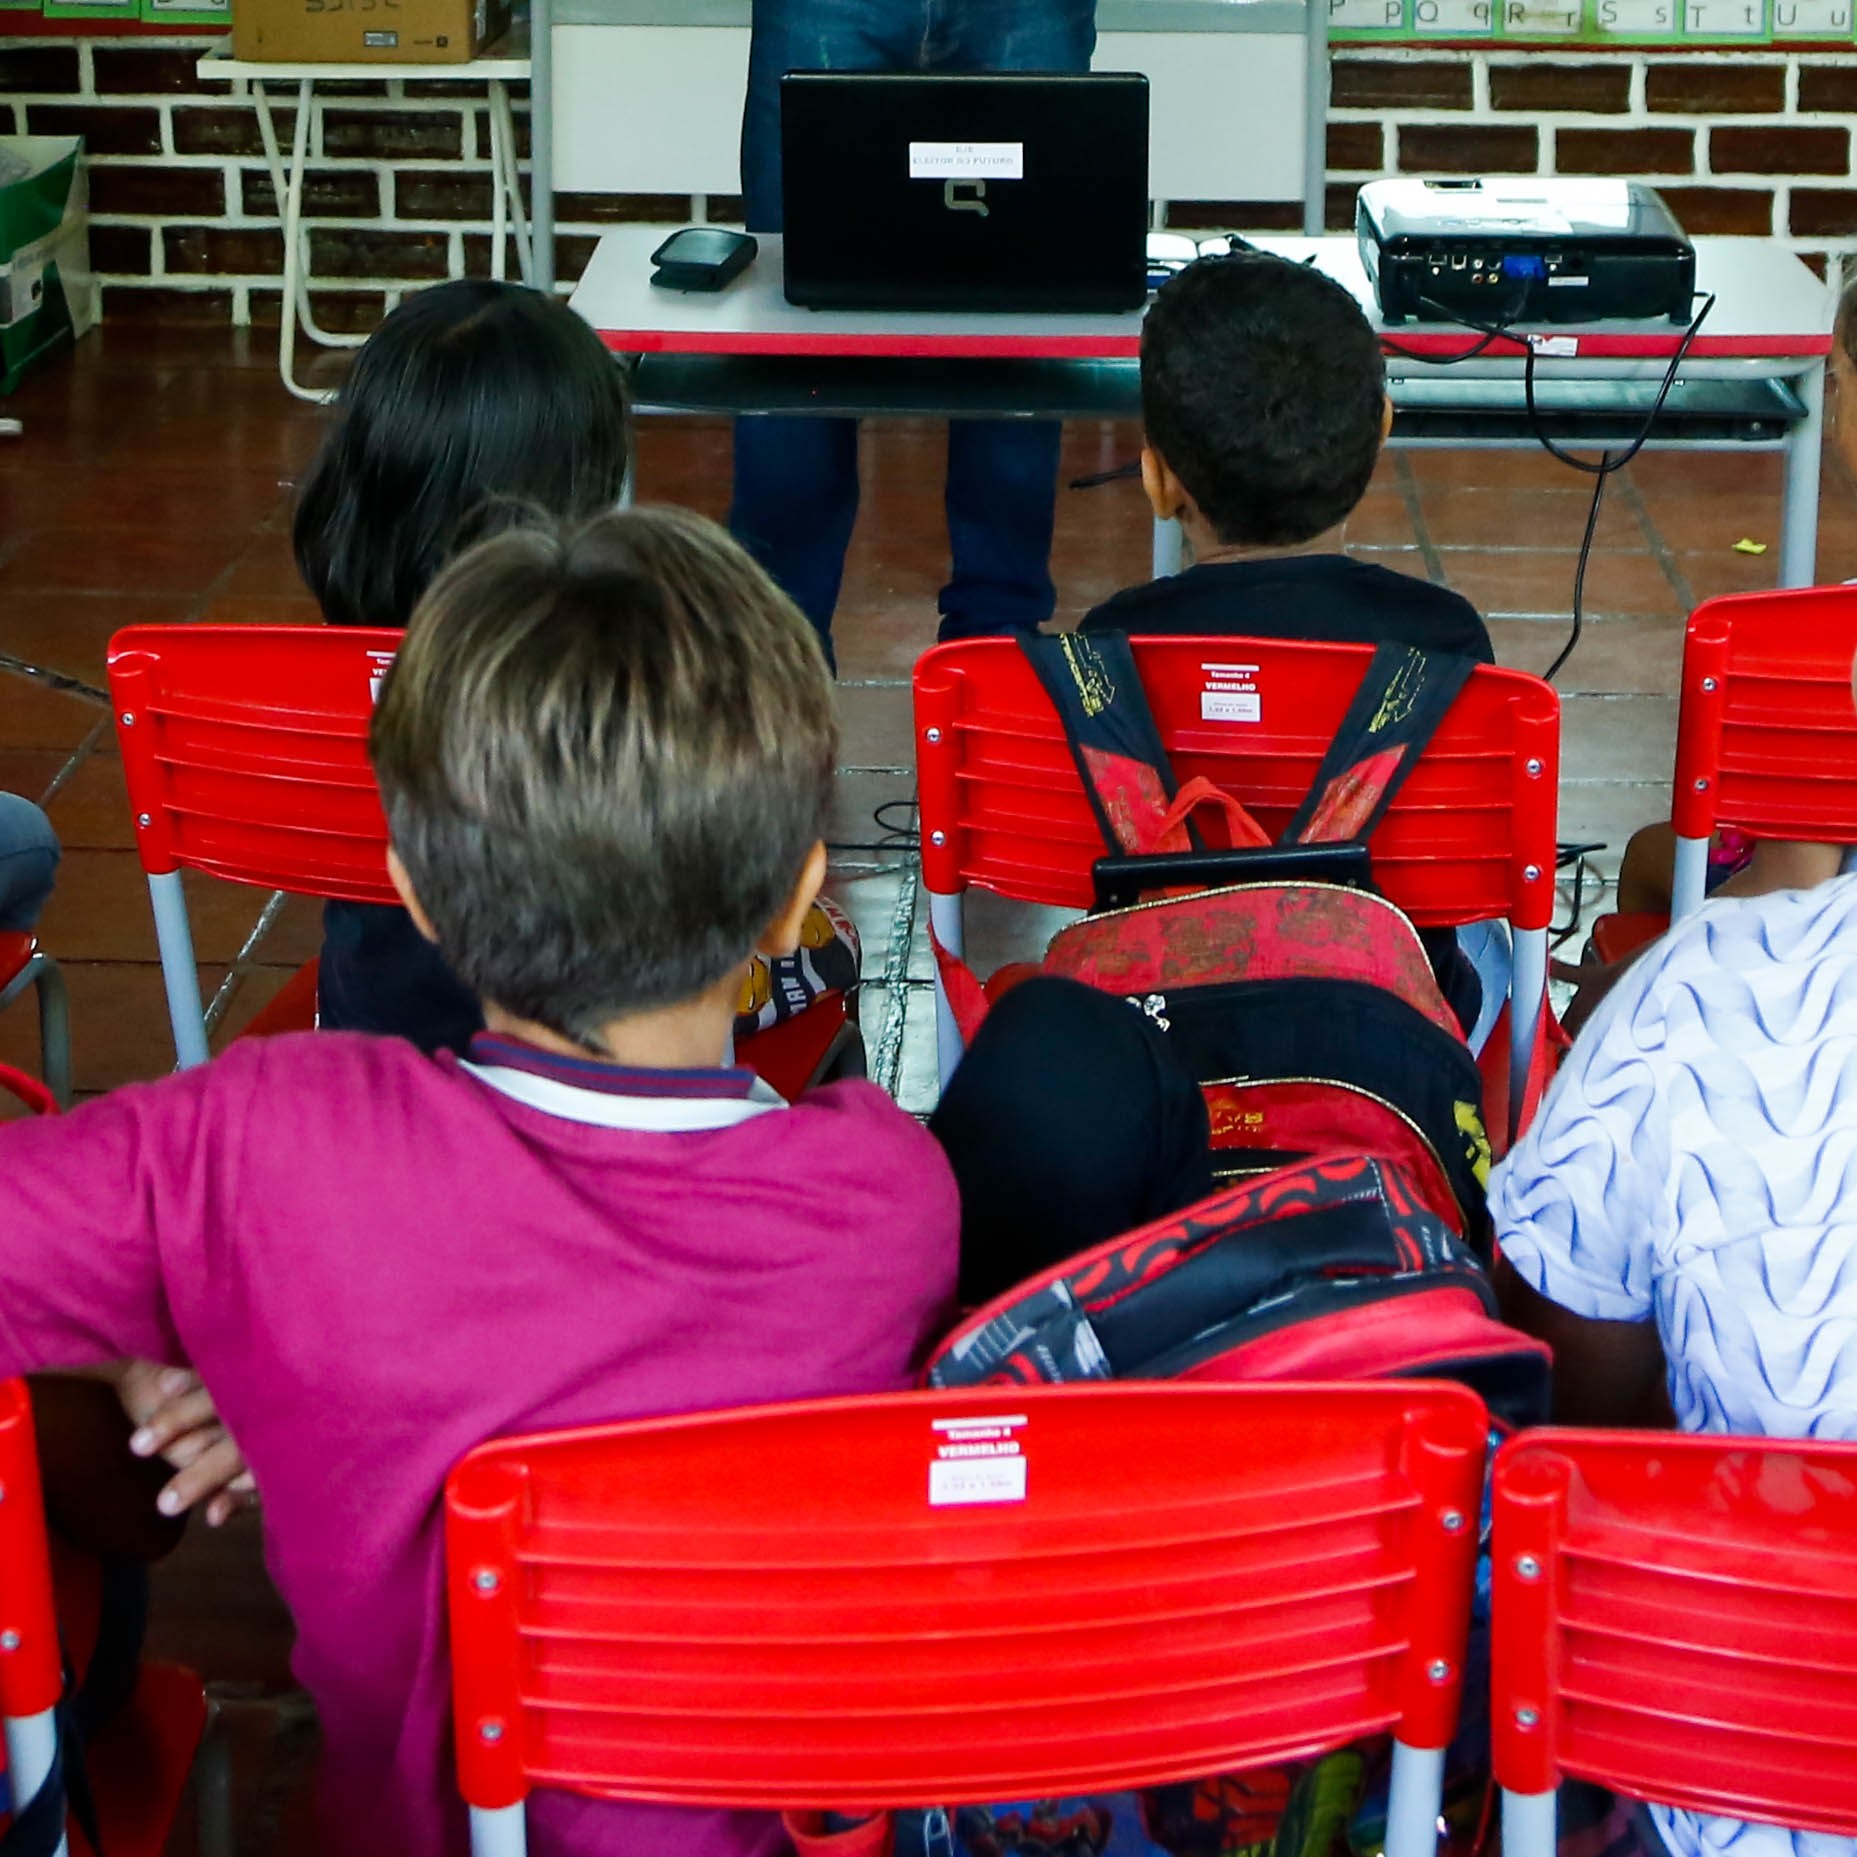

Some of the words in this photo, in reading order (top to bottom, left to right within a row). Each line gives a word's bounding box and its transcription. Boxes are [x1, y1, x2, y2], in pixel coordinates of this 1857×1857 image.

[1385, 0, 1401, 24] p
[1417, 0, 1439, 23] Q
[1473, 3, 1489, 26] q
[1509, 1, 1525, 24] R
[1566, 9, 1576, 27] r
[1601, 0, 1618, 24] S
[1655, 6, 1667, 24] s
[1690, 5, 1707, 28] T
[1744, 5, 1753, 25] t
[1777, 4, 1796, 26] U
[1830, 10, 1846, 26] u
[1205, 681, 1256, 691] VERMELHO
[938, 1441, 1020, 1459] VERMELHO
